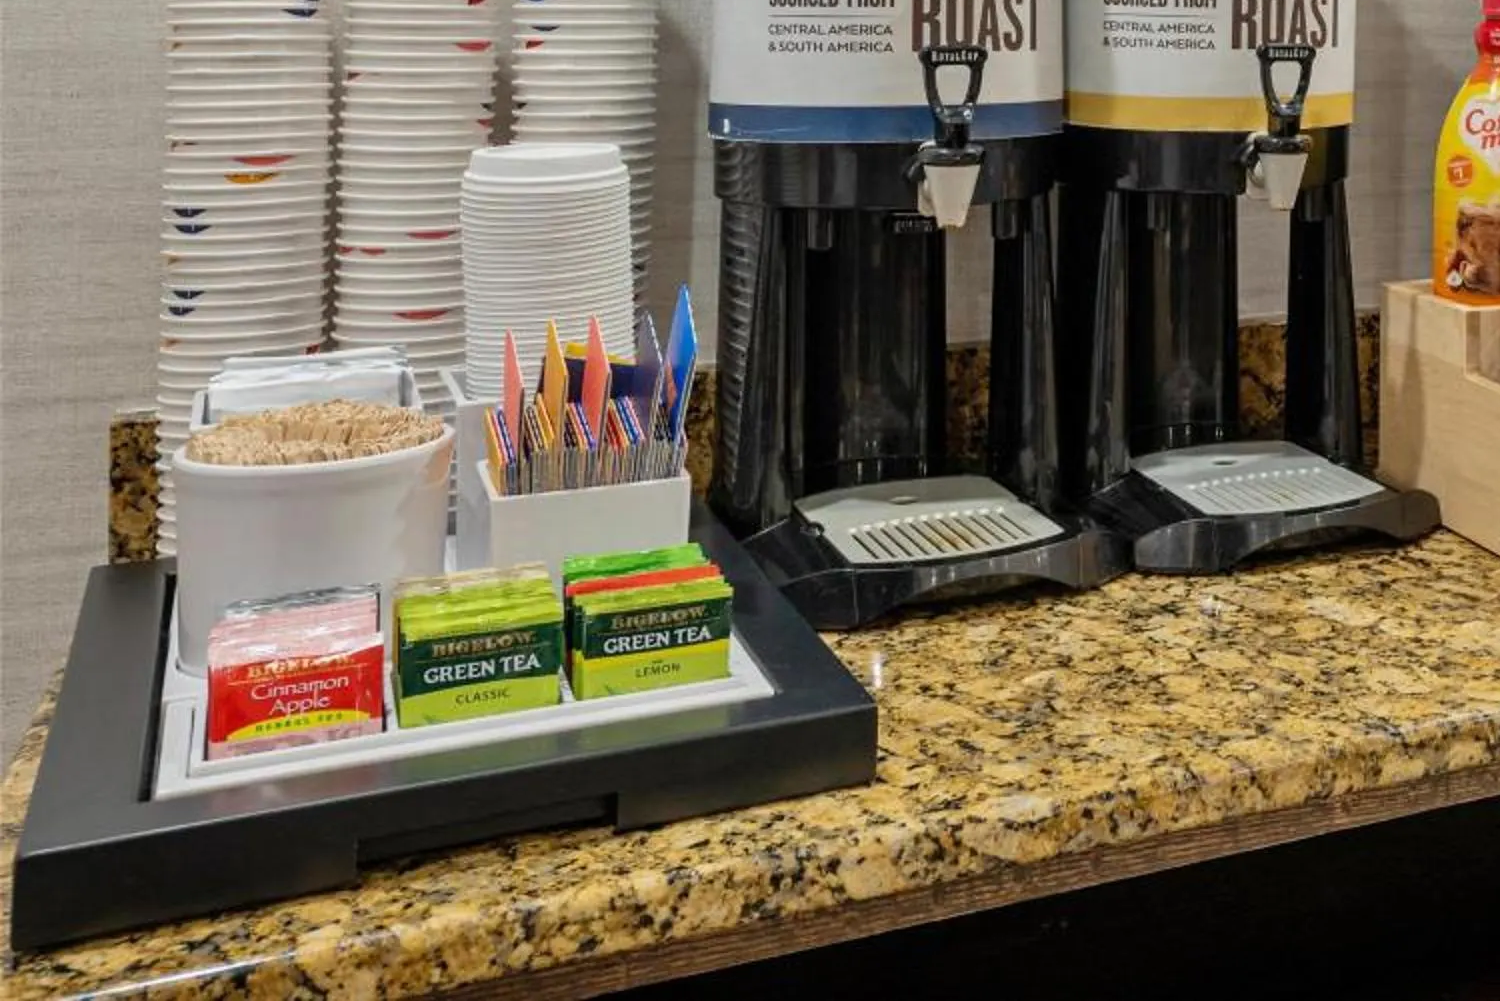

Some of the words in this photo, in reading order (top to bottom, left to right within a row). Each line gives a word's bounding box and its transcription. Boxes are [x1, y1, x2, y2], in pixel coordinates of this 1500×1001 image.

[768, 22, 825, 36] CENTRAL
[826, 23, 893, 36] AMERICA
[1103, 20, 1154, 33] CENTRAL
[1157, 21, 1215, 34] AMERICA
[768, 41, 776, 53] &
[777, 41, 824, 53] SOUTH
[826, 41, 895, 53] AMERICA
[1103, 36, 1111, 47] &
[1112, 37, 1153, 49] SOUTH
[1156, 38, 1215, 50] AMERICA
[432, 631, 535, 657] BIGELOW
[603, 632, 670, 654] GREEN
[673, 625, 712, 644] TEA
[424, 659, 495, 684] GREEN
[500, 653, 541, 673] TEA
[635, 663, 681, 678] LEMON
[251, 676, 349, 700] Cinnamon
[455, 688, 511, 705] CLASSIC
[269, 693, 331, 716] Apple
